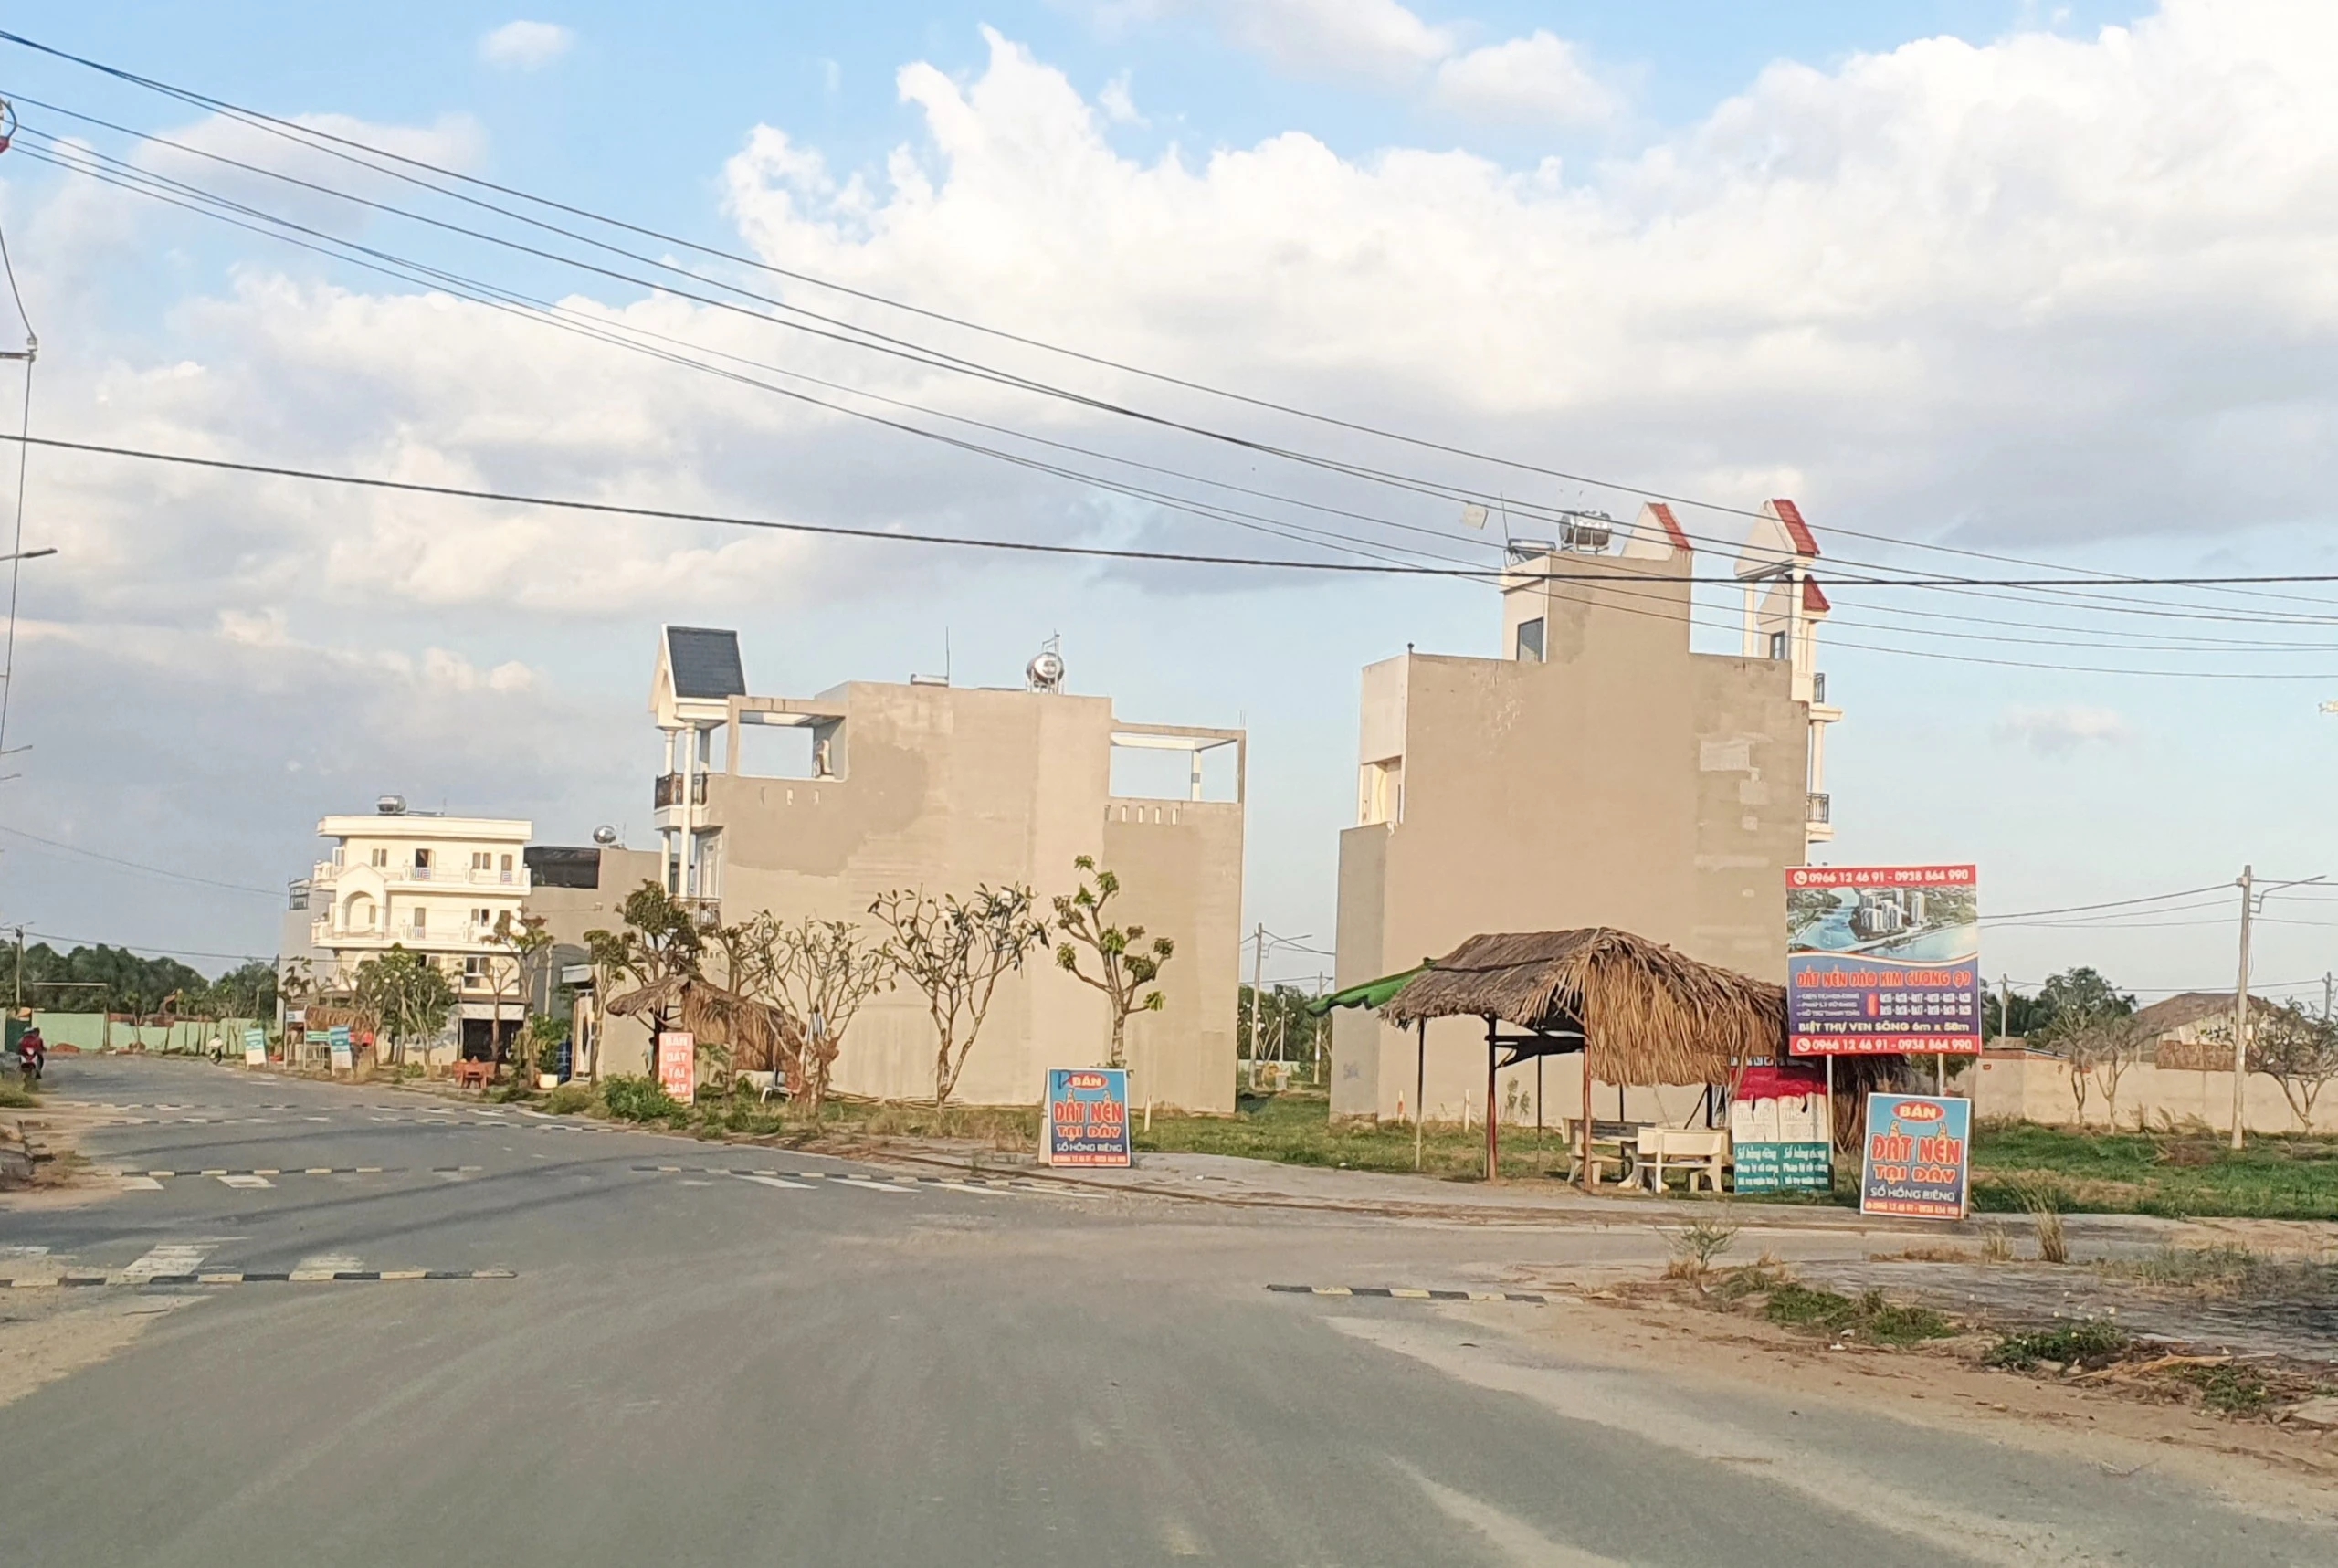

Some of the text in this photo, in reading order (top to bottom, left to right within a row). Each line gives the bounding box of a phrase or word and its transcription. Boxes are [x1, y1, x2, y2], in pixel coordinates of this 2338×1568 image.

[1809, 871, 1837, 883] 0966
[1839, 871, 1852, 883] 12
[1855, 870, 1869, 883] 46
[1871, 870, 1885, 883] 91
[1895, 870, 1922, 881] 0938
[1948, 868, 1969, 881] 990
[1879, 970, 1903, 987] KIM
[1824, 1021, 1847, 1034] THỰ
[1849, 1022, 1872, 1031] VEN
[1875, 1020, 1910, 1031] SÔNG
[1912, 1022, 1931, 1031] 6m
[1812, 1038, 1840, 1050] 0966
[1843, 1038, 1856, 1050] 12
[1859, 1038, 1873, 1050] 46
[1875, 1038, 1888, 1050] 91
[1898, 1038, 1925, 1050] 0938
[1928, 1038, 1949, 1049] 864
[1952, 1038, 1973, 1049] 990
[1072, 1075, 1101, 1087] BÁN
[1053, 1089, 1124, 1124] ĐẤT NỀN
[1899, 1104, 1936, 1118] BÁN
[1056, 1124, 1122, 1142] TẠI ĐÂY
[1870, 1121, 1962, 1166] ĐẤT NỀN
[1873, 1164, 1956, 1184] TẠI ĐÂY
